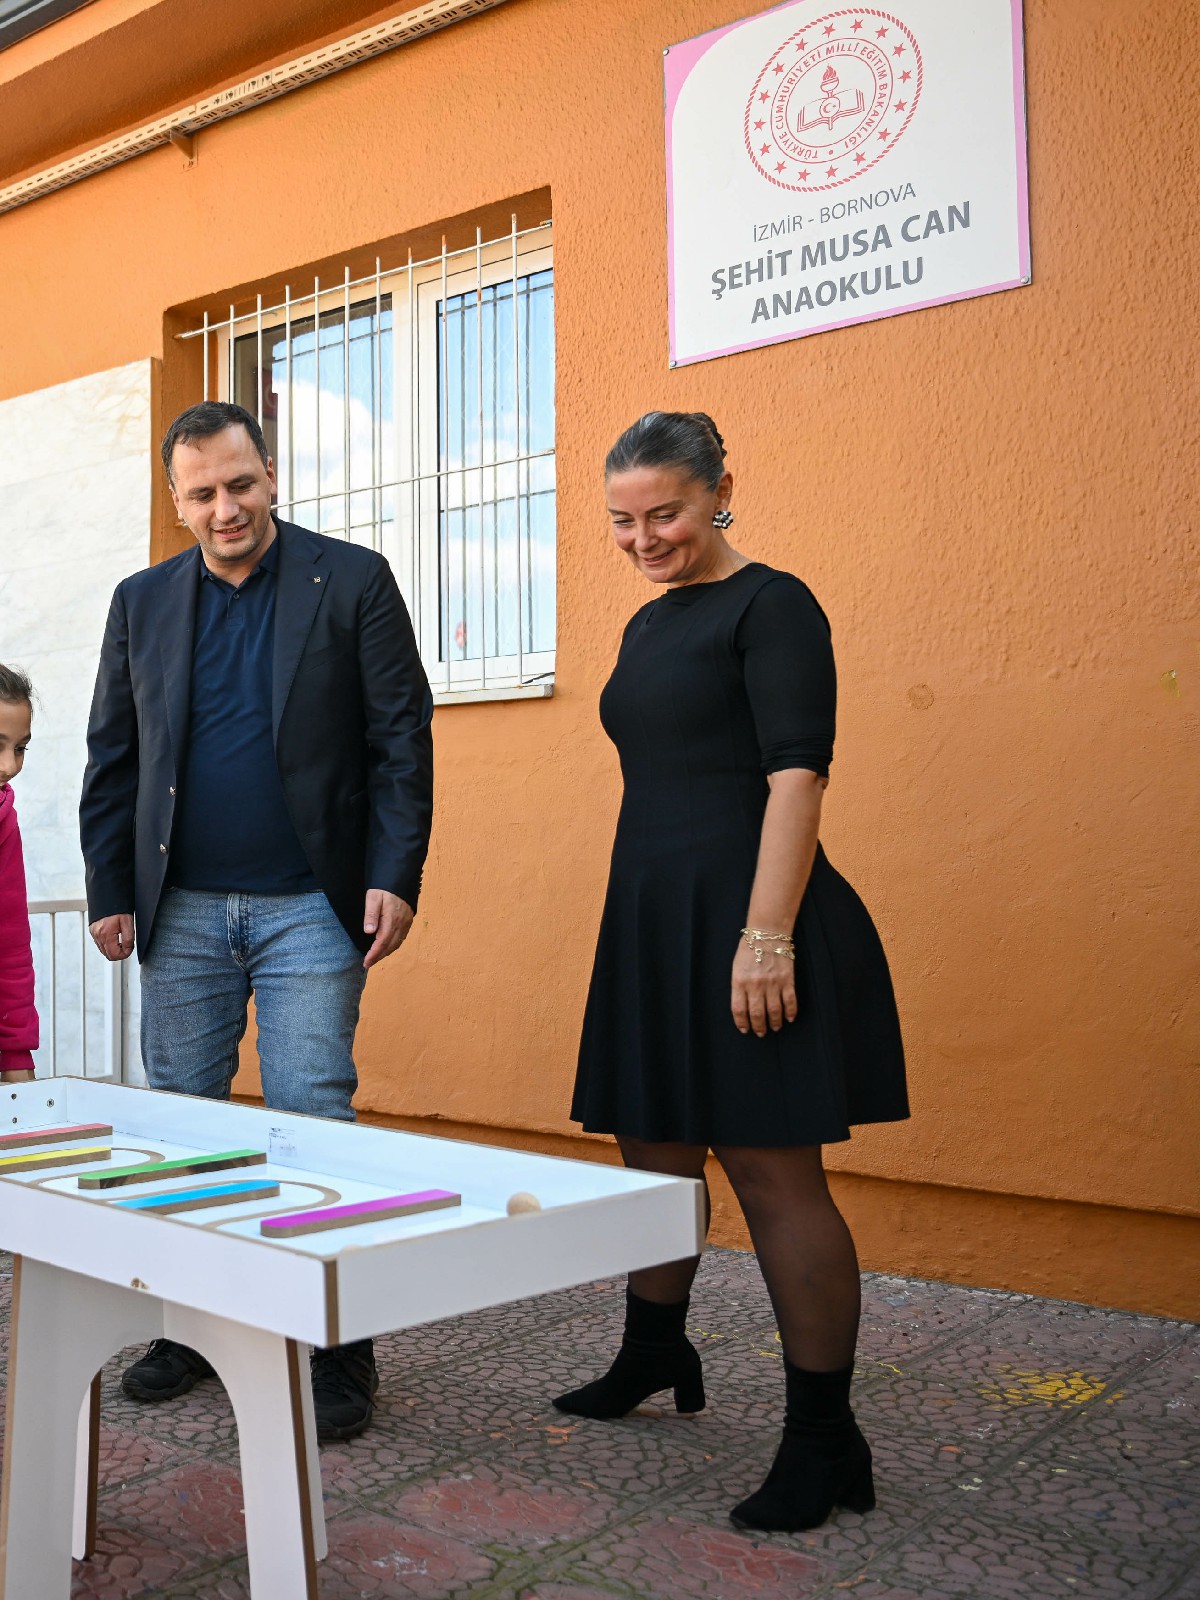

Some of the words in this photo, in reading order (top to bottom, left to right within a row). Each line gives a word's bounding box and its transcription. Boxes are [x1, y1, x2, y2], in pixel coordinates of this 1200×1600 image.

[825, 42, 859, 56] MİLLİ
[860, 46, 888, 80] EĞİTİM
[775, 50, 822, 129] CUMHURİYETİ
[843, 83, 888, 149] BAKANLIĞI
[779, 132, 819, 160] TÜRKİYE
[753, 216, 803, 242] İZMİR
[820, 182, 917, 224] BORNOVA
[711, 249, 793, 300] ŞEHİT
[800, 224, 893, 272] MUSA
[900, 200, 971, 243] CAN
[750, 256, 924, 324] ANAOKULU
